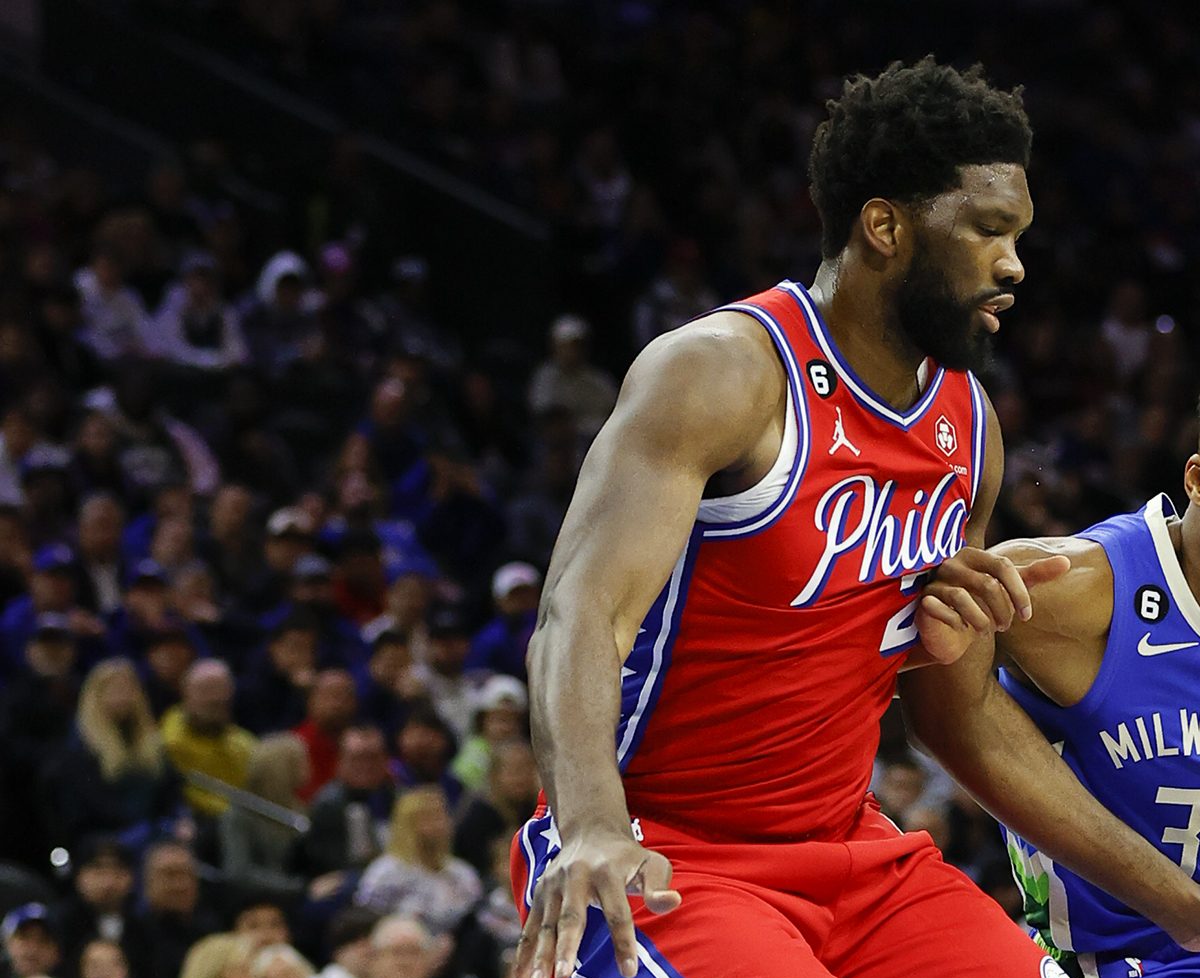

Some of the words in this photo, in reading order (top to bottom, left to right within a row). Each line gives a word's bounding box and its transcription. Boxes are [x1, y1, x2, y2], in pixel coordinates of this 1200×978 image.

[810, 365, 831, 396] 6
[790, 472, 968, 608] Phila
[1140, 589, 1162, 620] 6
